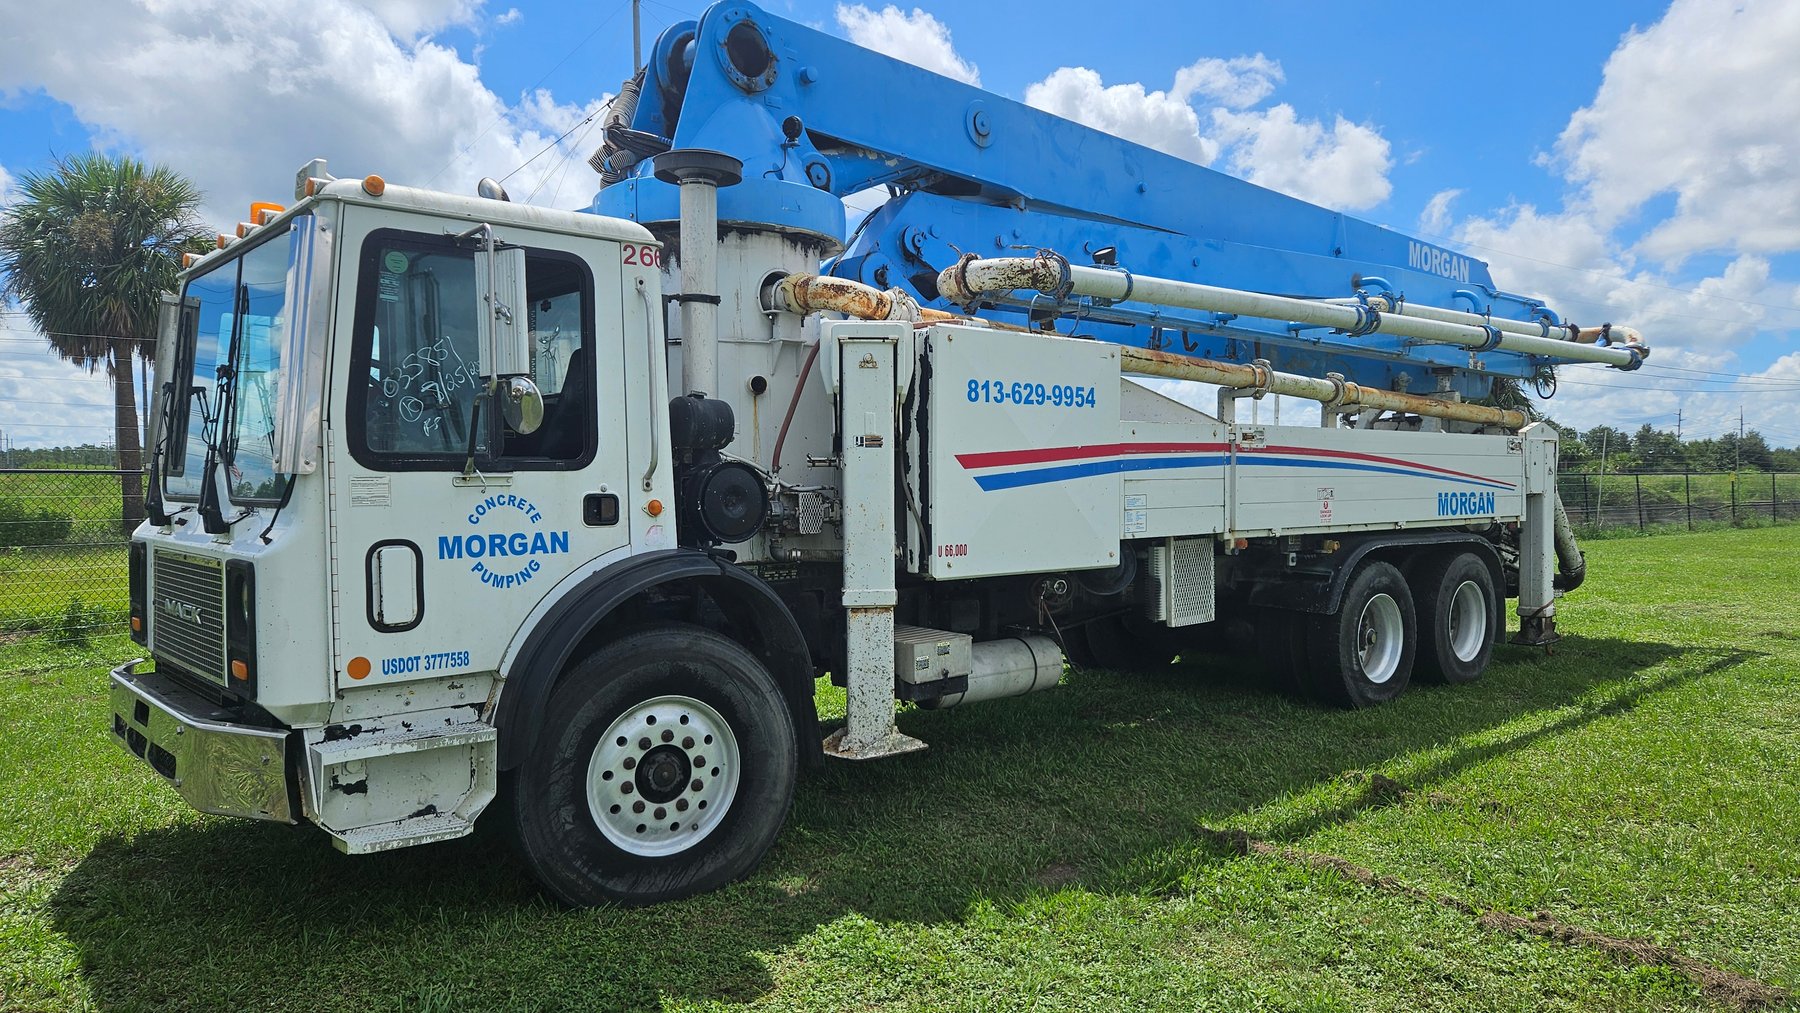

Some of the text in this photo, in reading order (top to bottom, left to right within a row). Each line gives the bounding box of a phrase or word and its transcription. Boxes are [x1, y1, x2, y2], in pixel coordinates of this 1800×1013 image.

[1408, 240, 1470, 284] MORGAN
[967, 379, 1096, 408] 813-629-9954
[468, 494, 542, 525] CONCRETE
[1438, 491, 1495, 516] MORGAN
[438, 531, 569, 560] MORGAN
[470, 559, 541, 589] PUMPING
[164, 598, 202, 625] MACK
[382, 650, 470, 676] USDOT 3777558
